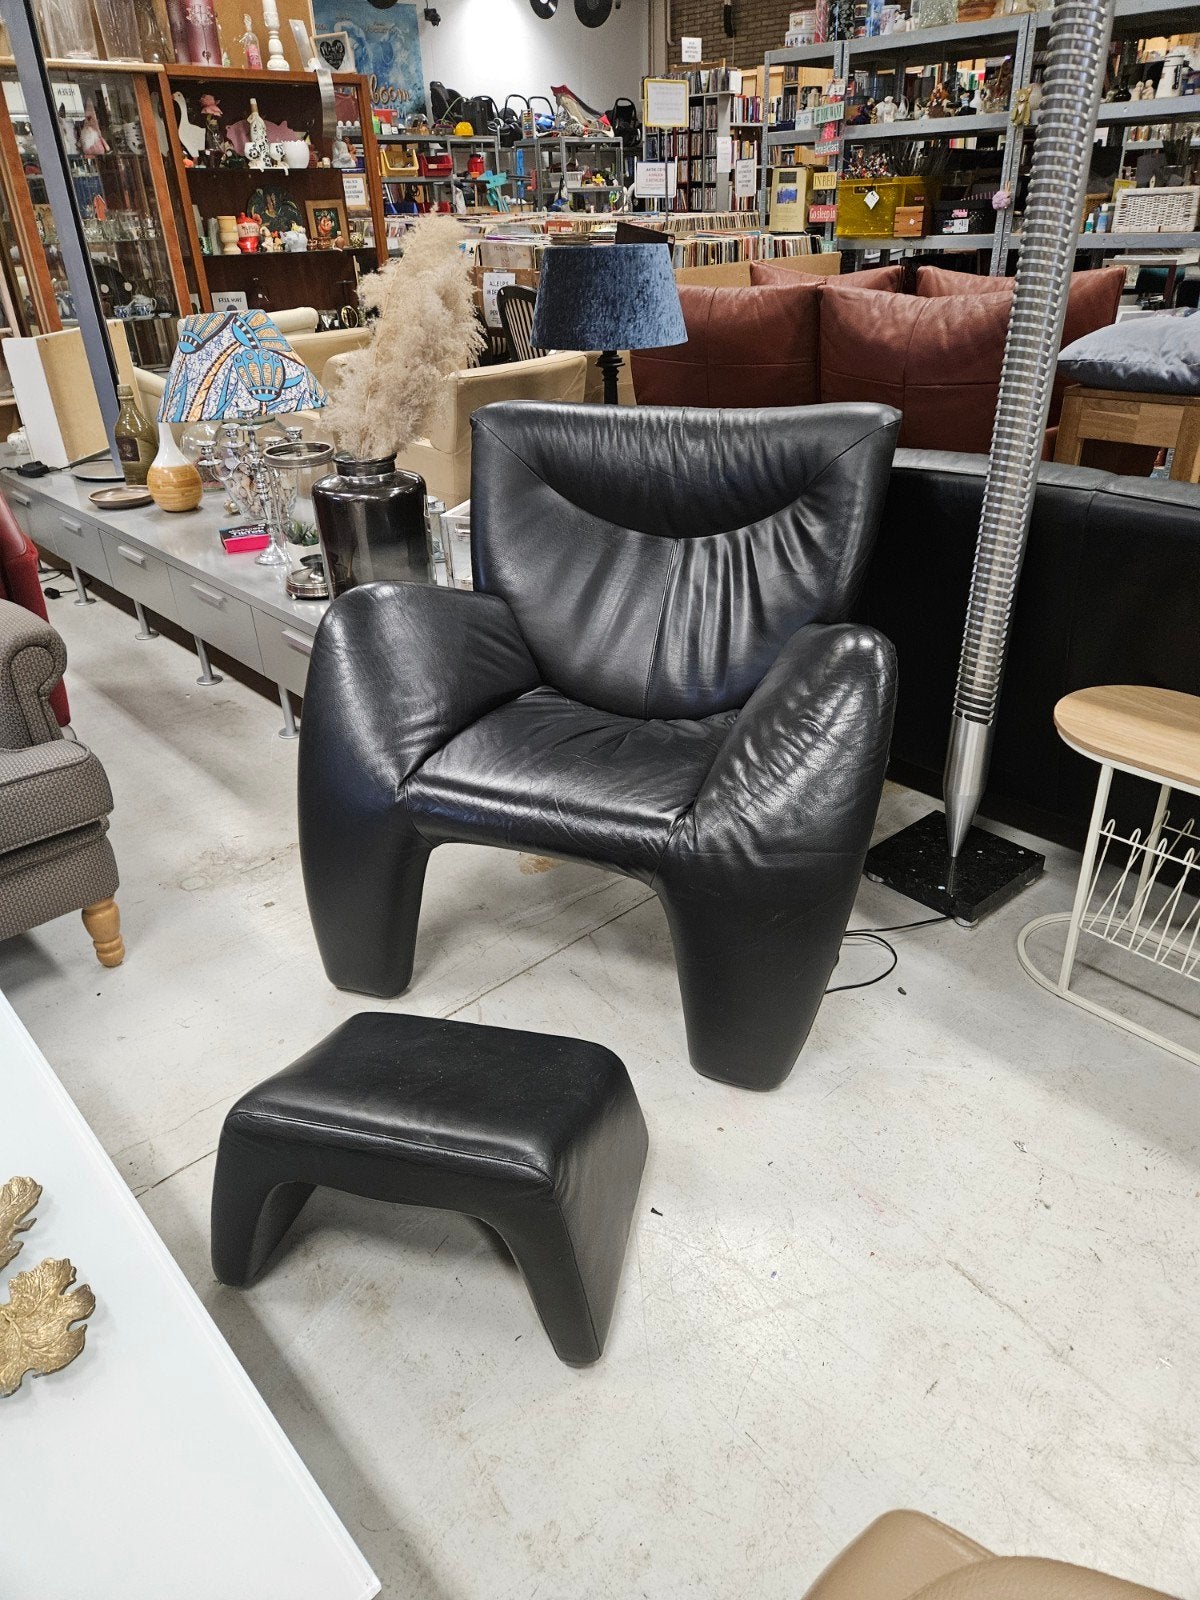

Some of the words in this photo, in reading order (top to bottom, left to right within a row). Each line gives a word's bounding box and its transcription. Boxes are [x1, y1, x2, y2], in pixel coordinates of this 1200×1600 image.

[814, 140, 839, 154] breakfast
[822, 174, 836, 187] BED
[810, 207, 817, 219] Go
[817, 207, 830, 221] sleep
